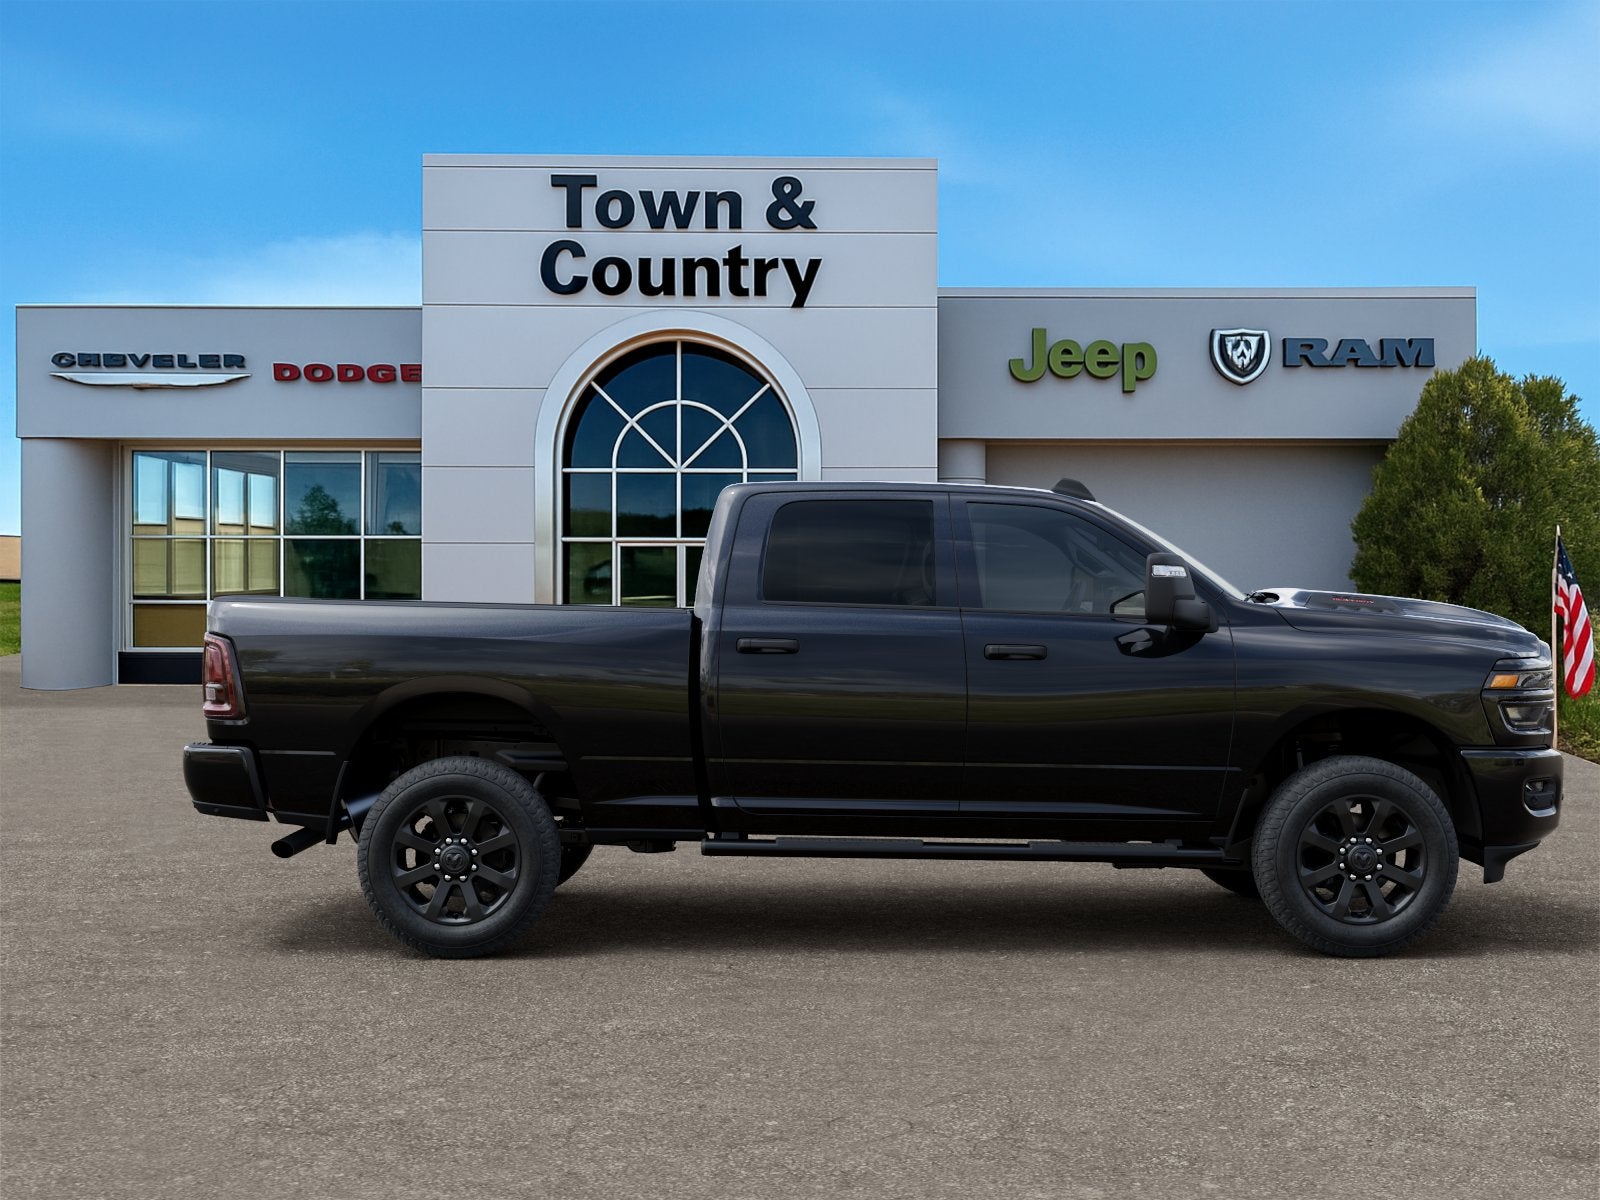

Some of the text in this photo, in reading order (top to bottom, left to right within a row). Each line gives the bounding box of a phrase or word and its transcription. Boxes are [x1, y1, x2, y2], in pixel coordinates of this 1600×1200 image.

[550, 174, 818, 229] Town &
[540, 239, 822, 308] Country
[273, 363, 422, 383] DODGE
[1009, 328, 1157, 393] Jeep
[1282, 337, 1435, 367] RAM
